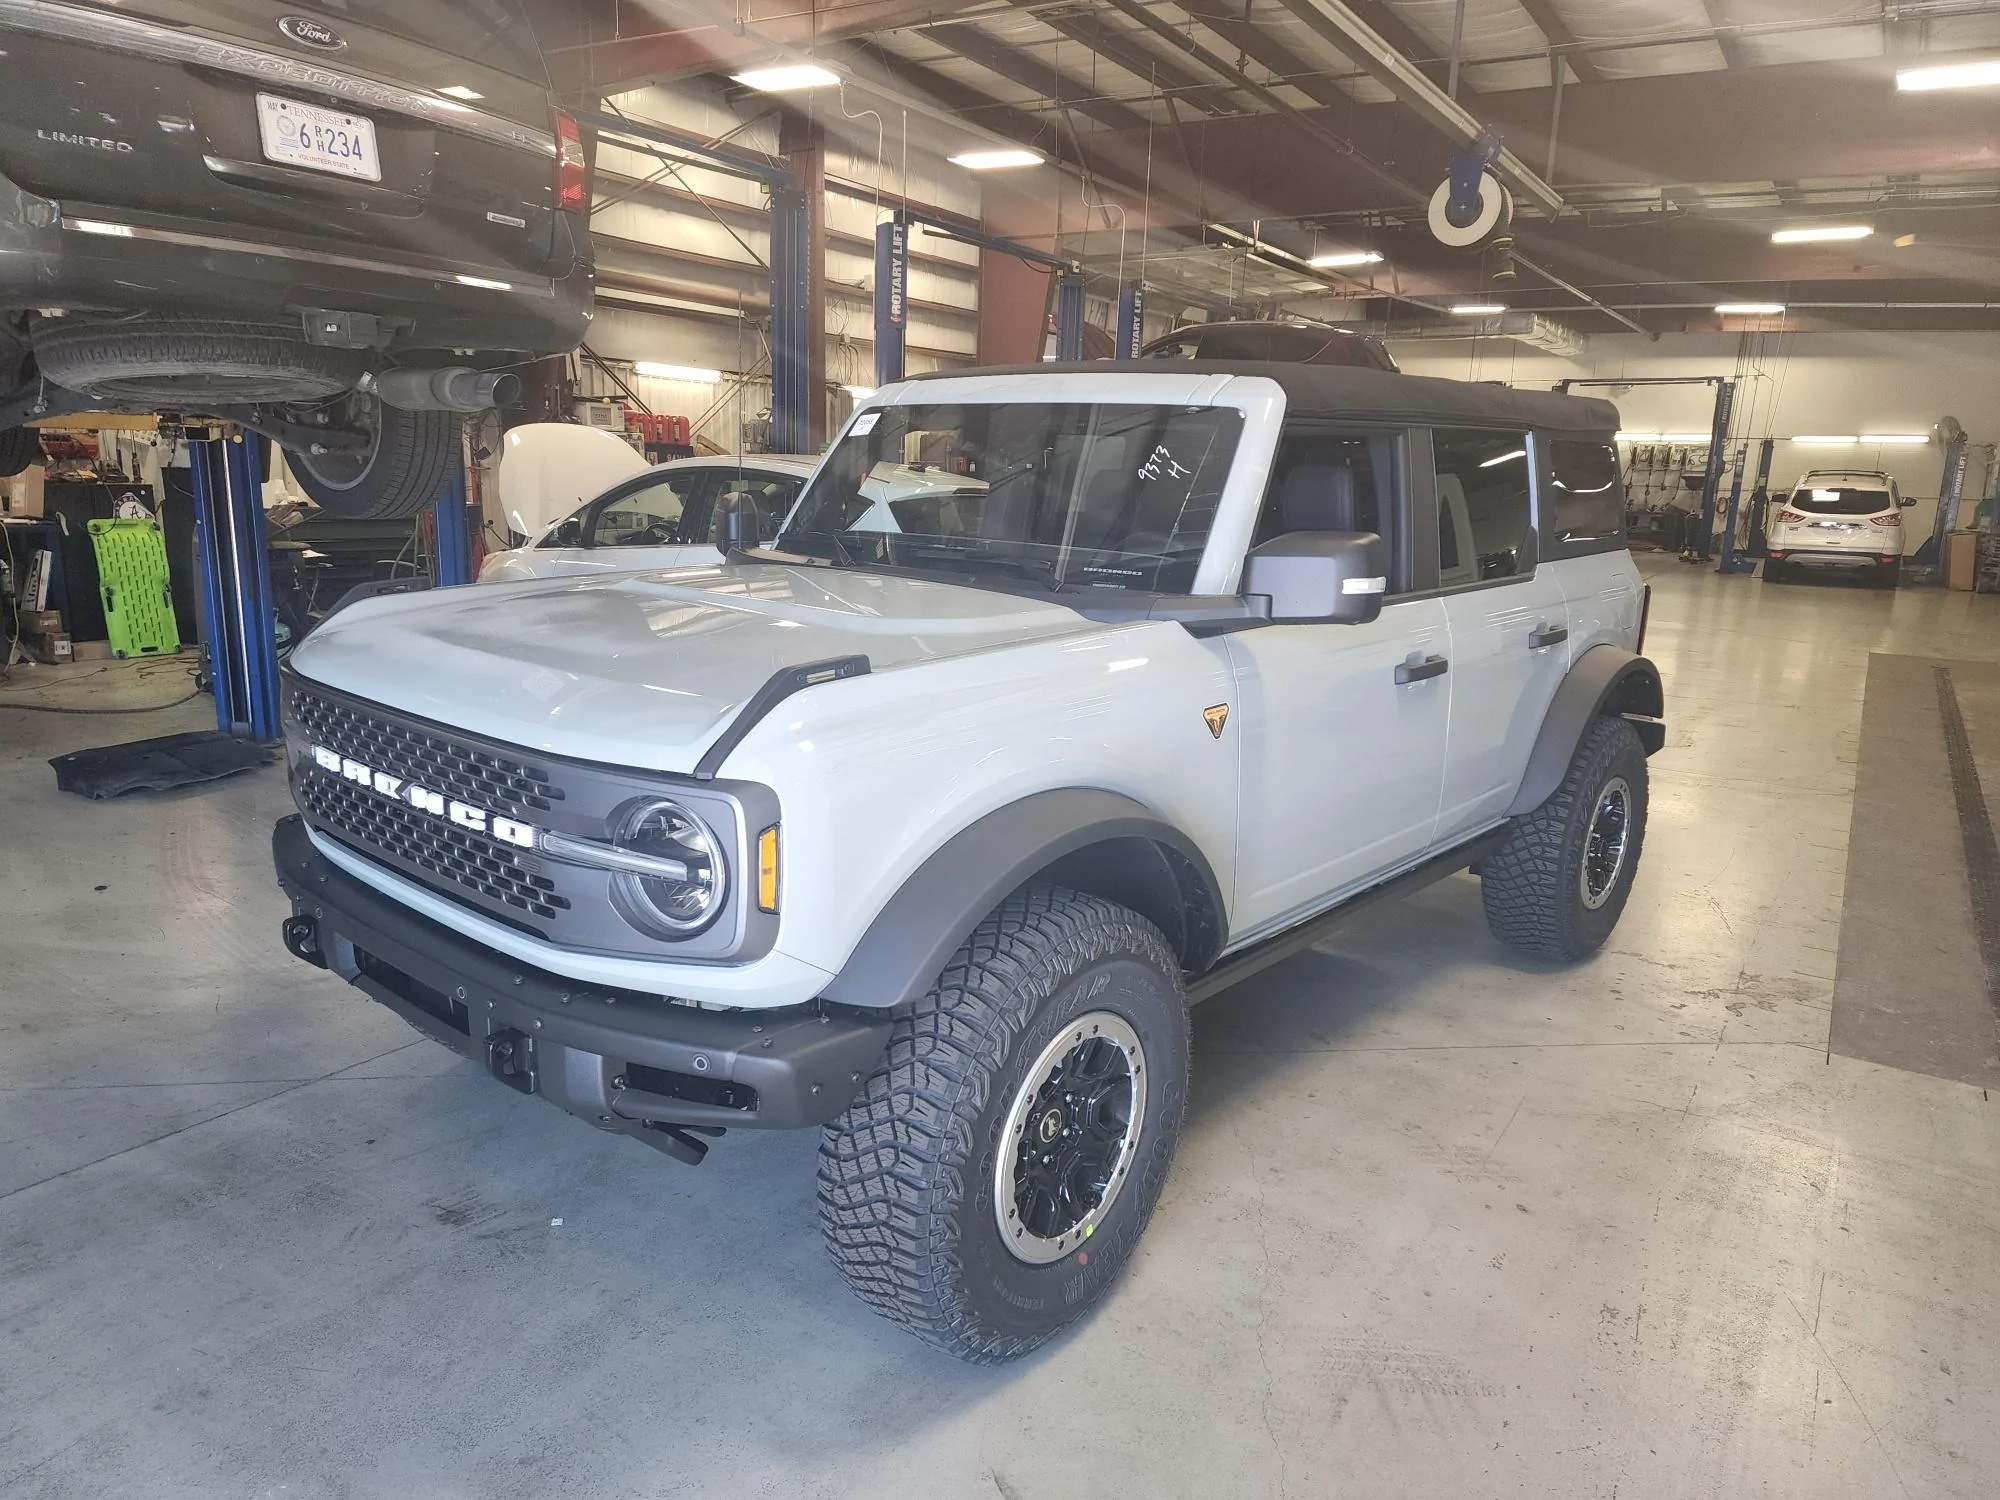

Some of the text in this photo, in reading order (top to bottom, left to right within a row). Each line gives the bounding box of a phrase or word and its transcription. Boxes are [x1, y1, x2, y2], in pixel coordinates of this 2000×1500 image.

[297, 20, 332, 43] Ford
[195, 44, 430, 113] EXPEDITION
[287, 105, 347, 127] TENNESSEE
[37, 129, 133, 153] LIMITED
[297, 152, 351, 170] VOLUNTEER STATE
[891, 223, 903, 315] ROTARY LIFT
[1131, 289, 1142, 359] ROTARY LIFT
[1138, 445, 1170, 481] 9373
[1167, 460, 1192, 479] H
[1083, 567, 1143, 576] BRONCO
[315, 745, 535, 848] BRONCO
